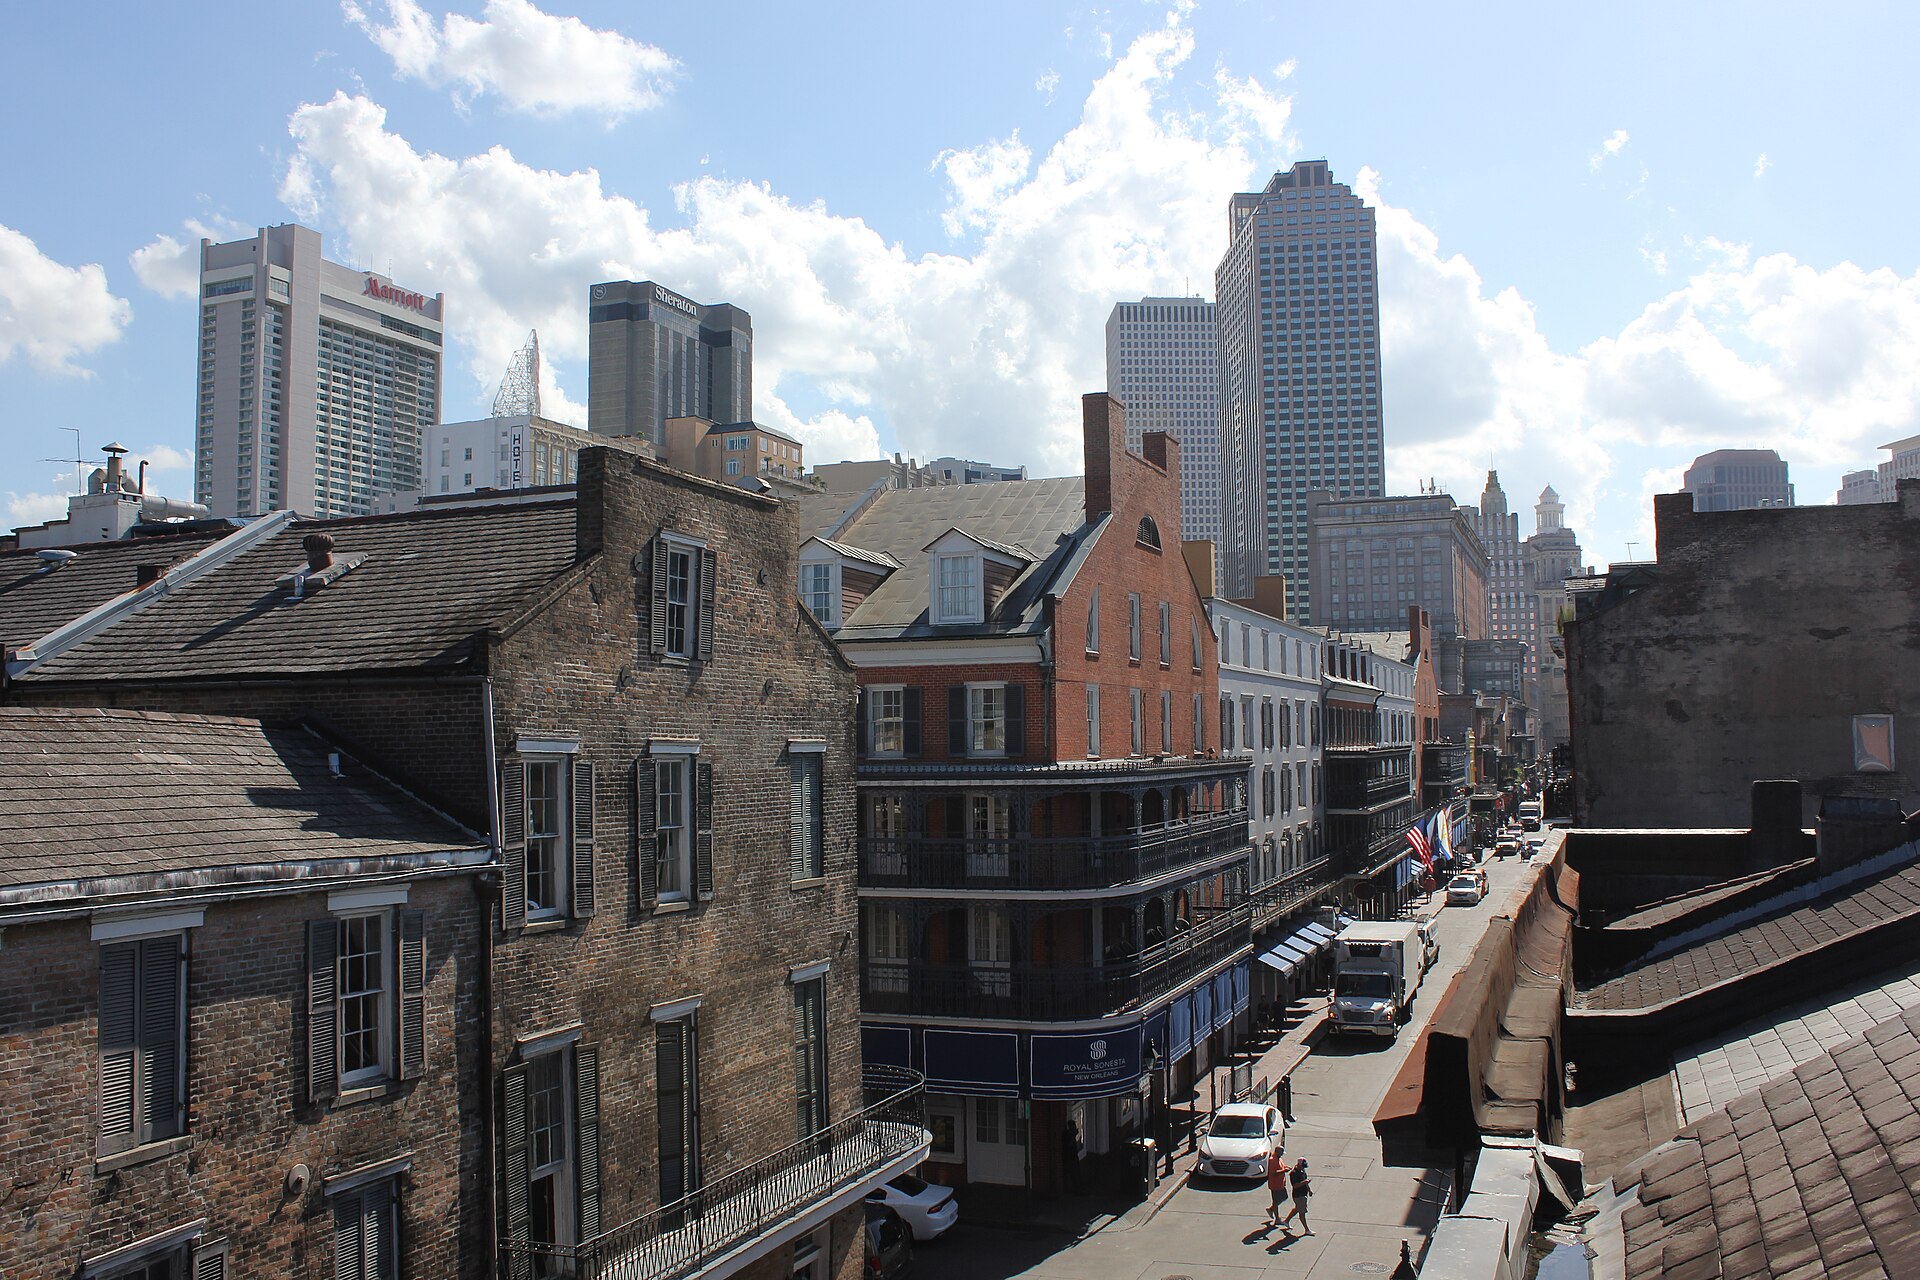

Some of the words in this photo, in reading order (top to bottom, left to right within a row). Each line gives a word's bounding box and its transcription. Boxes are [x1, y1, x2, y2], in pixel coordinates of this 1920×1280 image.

[362, 276, 424, 311] Marriott
[655, 285, 697, 316] Sheraton
[1063, 1064, 1091, 1072] ROYAL
[1094, 1058, 1126, 1070] SONESTA
[1091, 1070, 1118, 1079] ORLEANS
